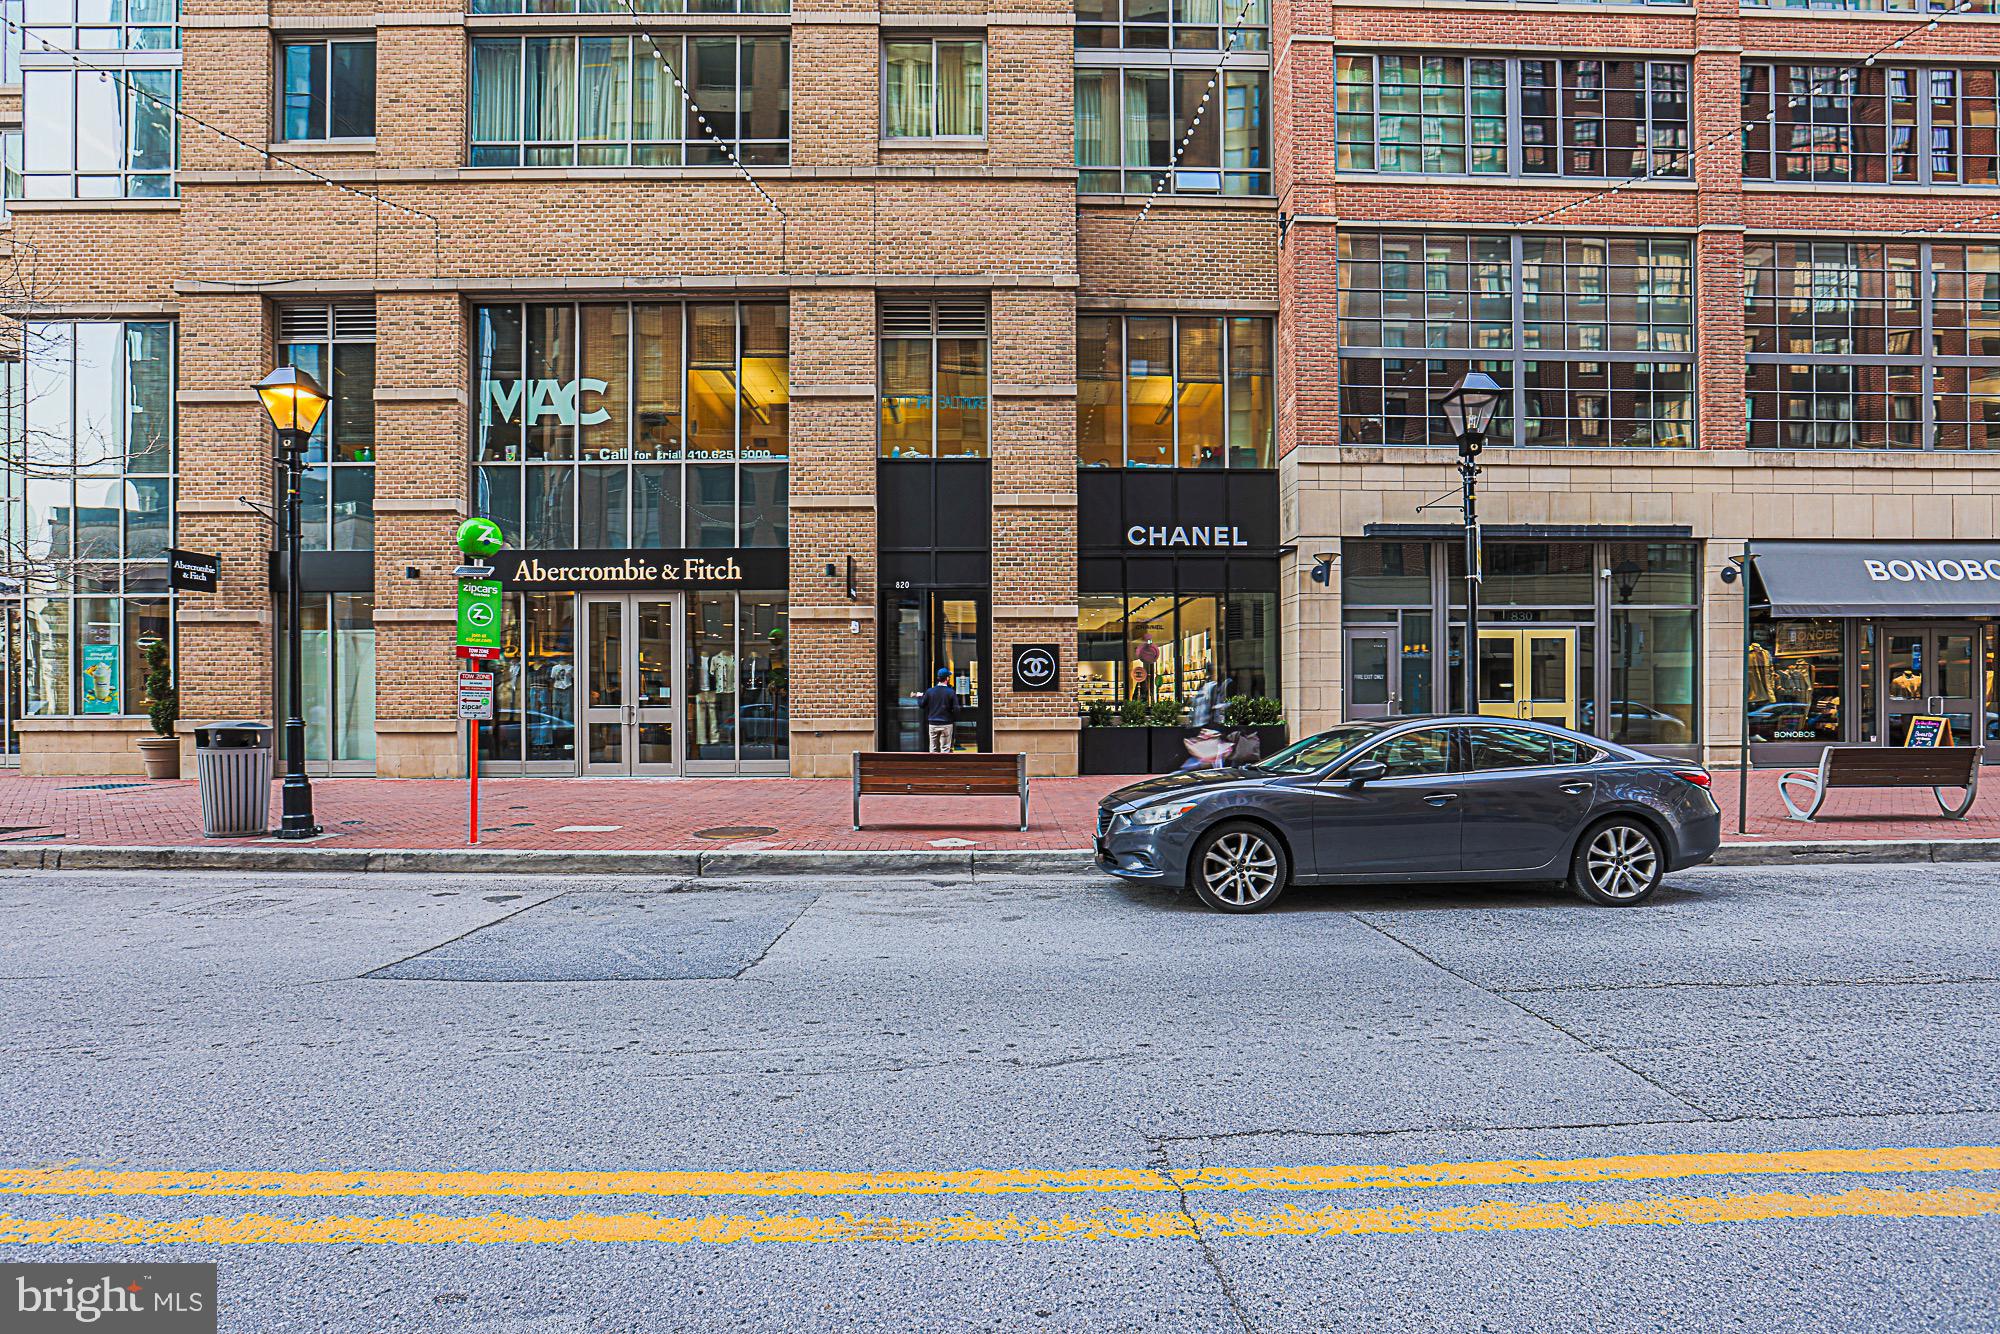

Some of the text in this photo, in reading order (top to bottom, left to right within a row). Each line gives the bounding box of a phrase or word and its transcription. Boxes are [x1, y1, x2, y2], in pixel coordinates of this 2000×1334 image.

[480, 378, 611, 426] MAC
[599, 448, 628, 460] Call
[634, 451, 651, 460] for
[656, 450, 682, 460] trial
[1127, 525, 1248, 546] CHANEL
[174, 560, 216, 574] Abercrombie
[512, 557, 742, 582] Abercrombie & Fitch
[190, 571, 207, 581] Fitch
[463, 582, 498, 596] zipcars
[895, 581, 910, 589] 820
[1511, 611, 1533, 621] 830
[461, 703, 482, 711] zipcar
